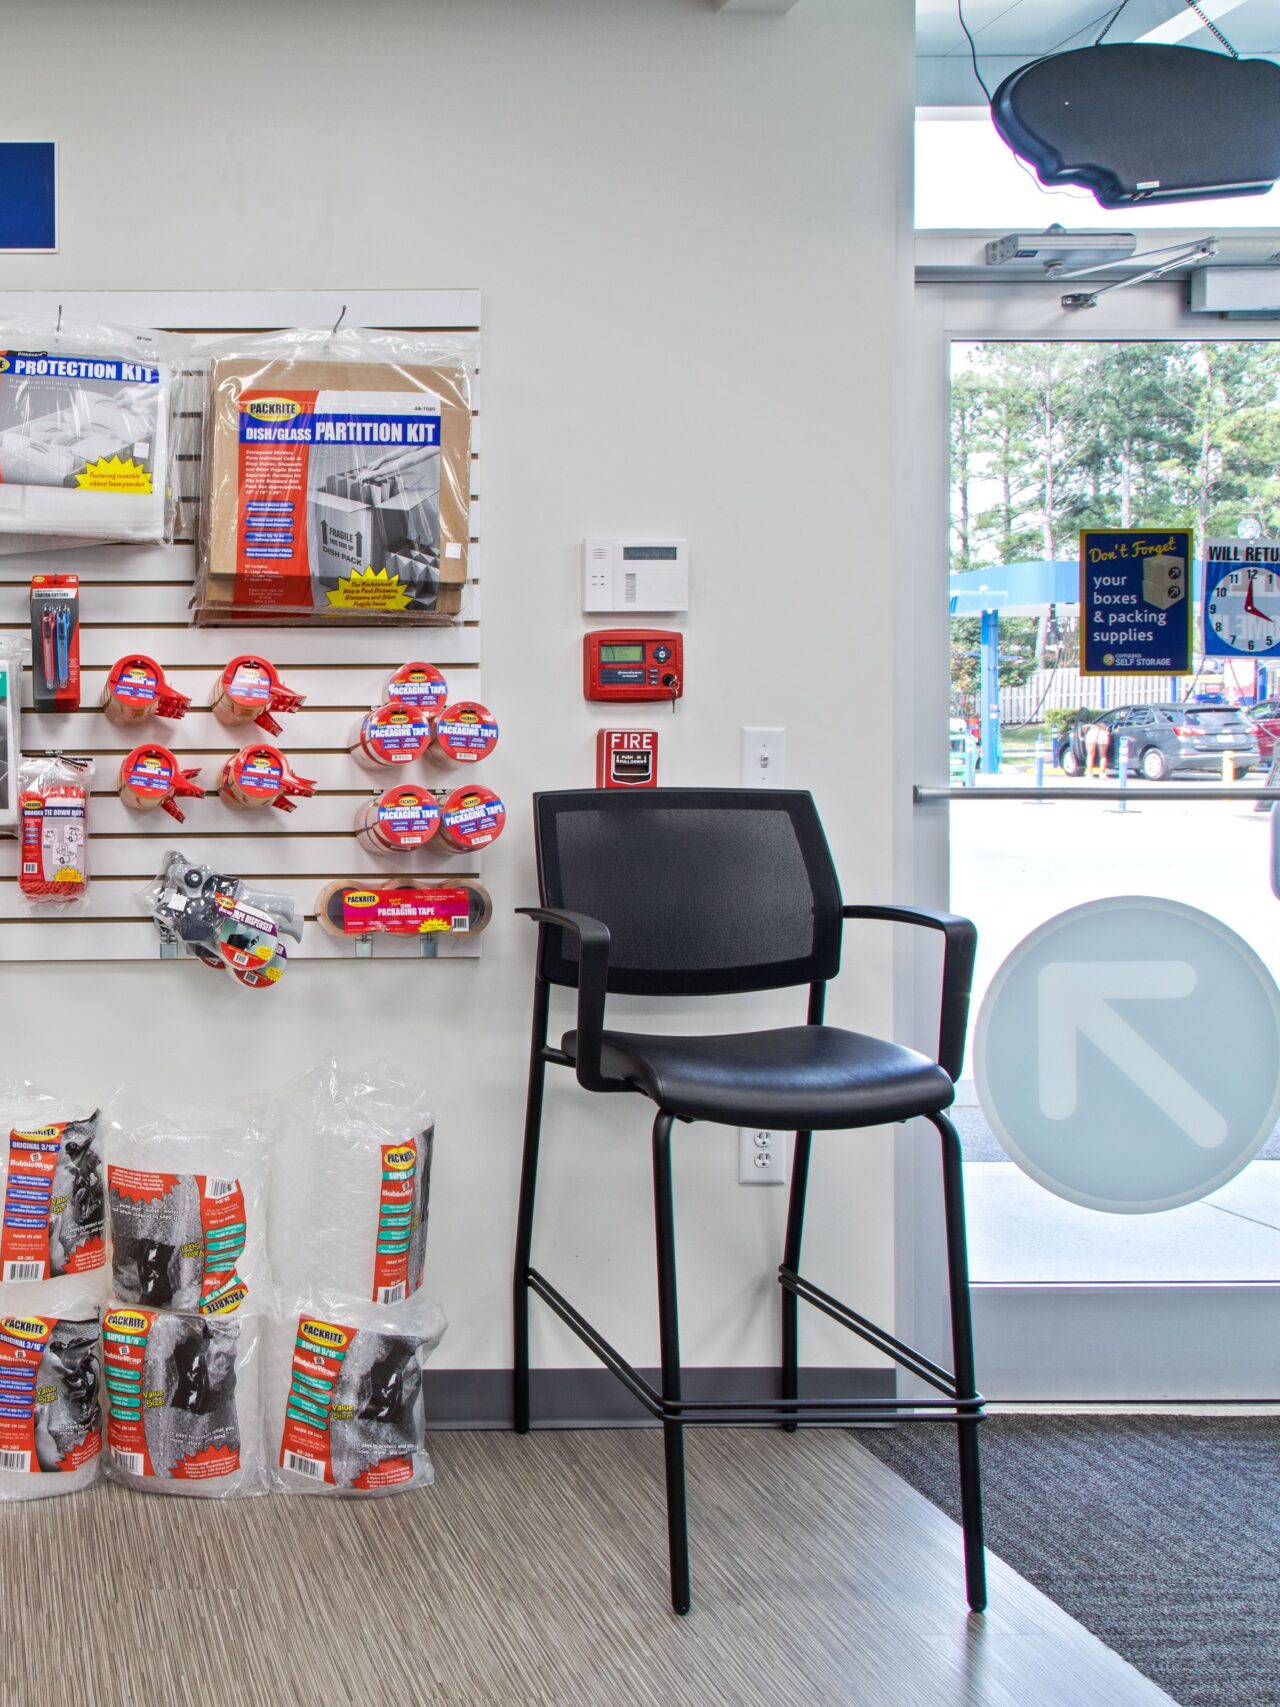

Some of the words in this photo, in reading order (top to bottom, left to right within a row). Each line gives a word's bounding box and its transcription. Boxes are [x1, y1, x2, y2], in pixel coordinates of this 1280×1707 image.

[15, 359, 116, 379] PROTECTION
[122, 363, 152, 382] KIT
[250, 404, 296, 413] PACKRITE
[246, 428, 311, 440] DISH/GLASS
[316, 422, 403, 442] PARTITION
[407, 424, 435, 442] KIT
[329, 527, 353, 543] FRAGILE
[323, 546, 340, 558] DISH
[341, 553, 362, 566] PACK
[1089, 544, 1128, 563] Don't
[1132, 537, 1177, 558] Forget
[1209, 546, 1240, 561] WILL
[1230, 574, 1238, 584] 11
[1268, 574, 1272, 584] 1
[1247, 569, 1258, 579] 12
[1094, 575, 1127, 588] your
[1094, 592, 1137, 604] boxes
[1216, 588, 1227, 598] 10
[1210, 604, 1216, 614] 9
[1094, 611, 1104, 623] &
[1108, 609, 1167, 626] packing
[1215, 622, 1222, 631] 8
[1093, 629, 1154, 644] supplies
[1230, 635, 1236, 645] 7
[1266, 636, 1272, 646] 5
[1248, 641, 1254, 650] 6
[1115, 658, 1135, 666] SELF
[1136, 658, 1171, 666] STORAGE
[390, 687, 428, 695] PACKAGING
[431, 686, 447, 694] TAPE
[371, 729, 411, 738] PACKAGING
[413, 727, 429, 736] TAPE
[439, 726, 479, 736] PACKAGING
[481, 729, 497, 738] TAPE
[611, 733, 653, 749] FIRE
[380, 810, 420, 820] PACKAGING
[422, 809, 439, 818] TAPE
[445, 810, 486, 826] PACKAGING
[486, 804, 503, 814] TAPE
[378, 908, 415, 916] PACKAGING
[418, 907, 435, 915] TAPE
[245, 915, 273, 932] DISPENSER
[12, 1142, 40, 1150] ORIGINAL
[387, 1151, 415, 1163] PACKRITE
[10, 1159, 54, 1170] BubbleWrap
[207, 1289, 244, 1313] PACKRITE
[5, 1320, 44, 1334] PACKRITE
[108, 1315, 145, 1328] PACKRITE
[107, 1333, 126, 1344] SUPER
[303, 1324, 344, 1344] PACKRITE
[0, 1335, 26, 1348] ORIGINAL
[301, 1341, 320, 1354] SUPER
[293, 1356, 336, 1377] BubbleWrap
[36, 1386, 57, 1395] Value
[39, 1394, 57, 1404] Size!
[146, 1400, 165, 1408] Size!
